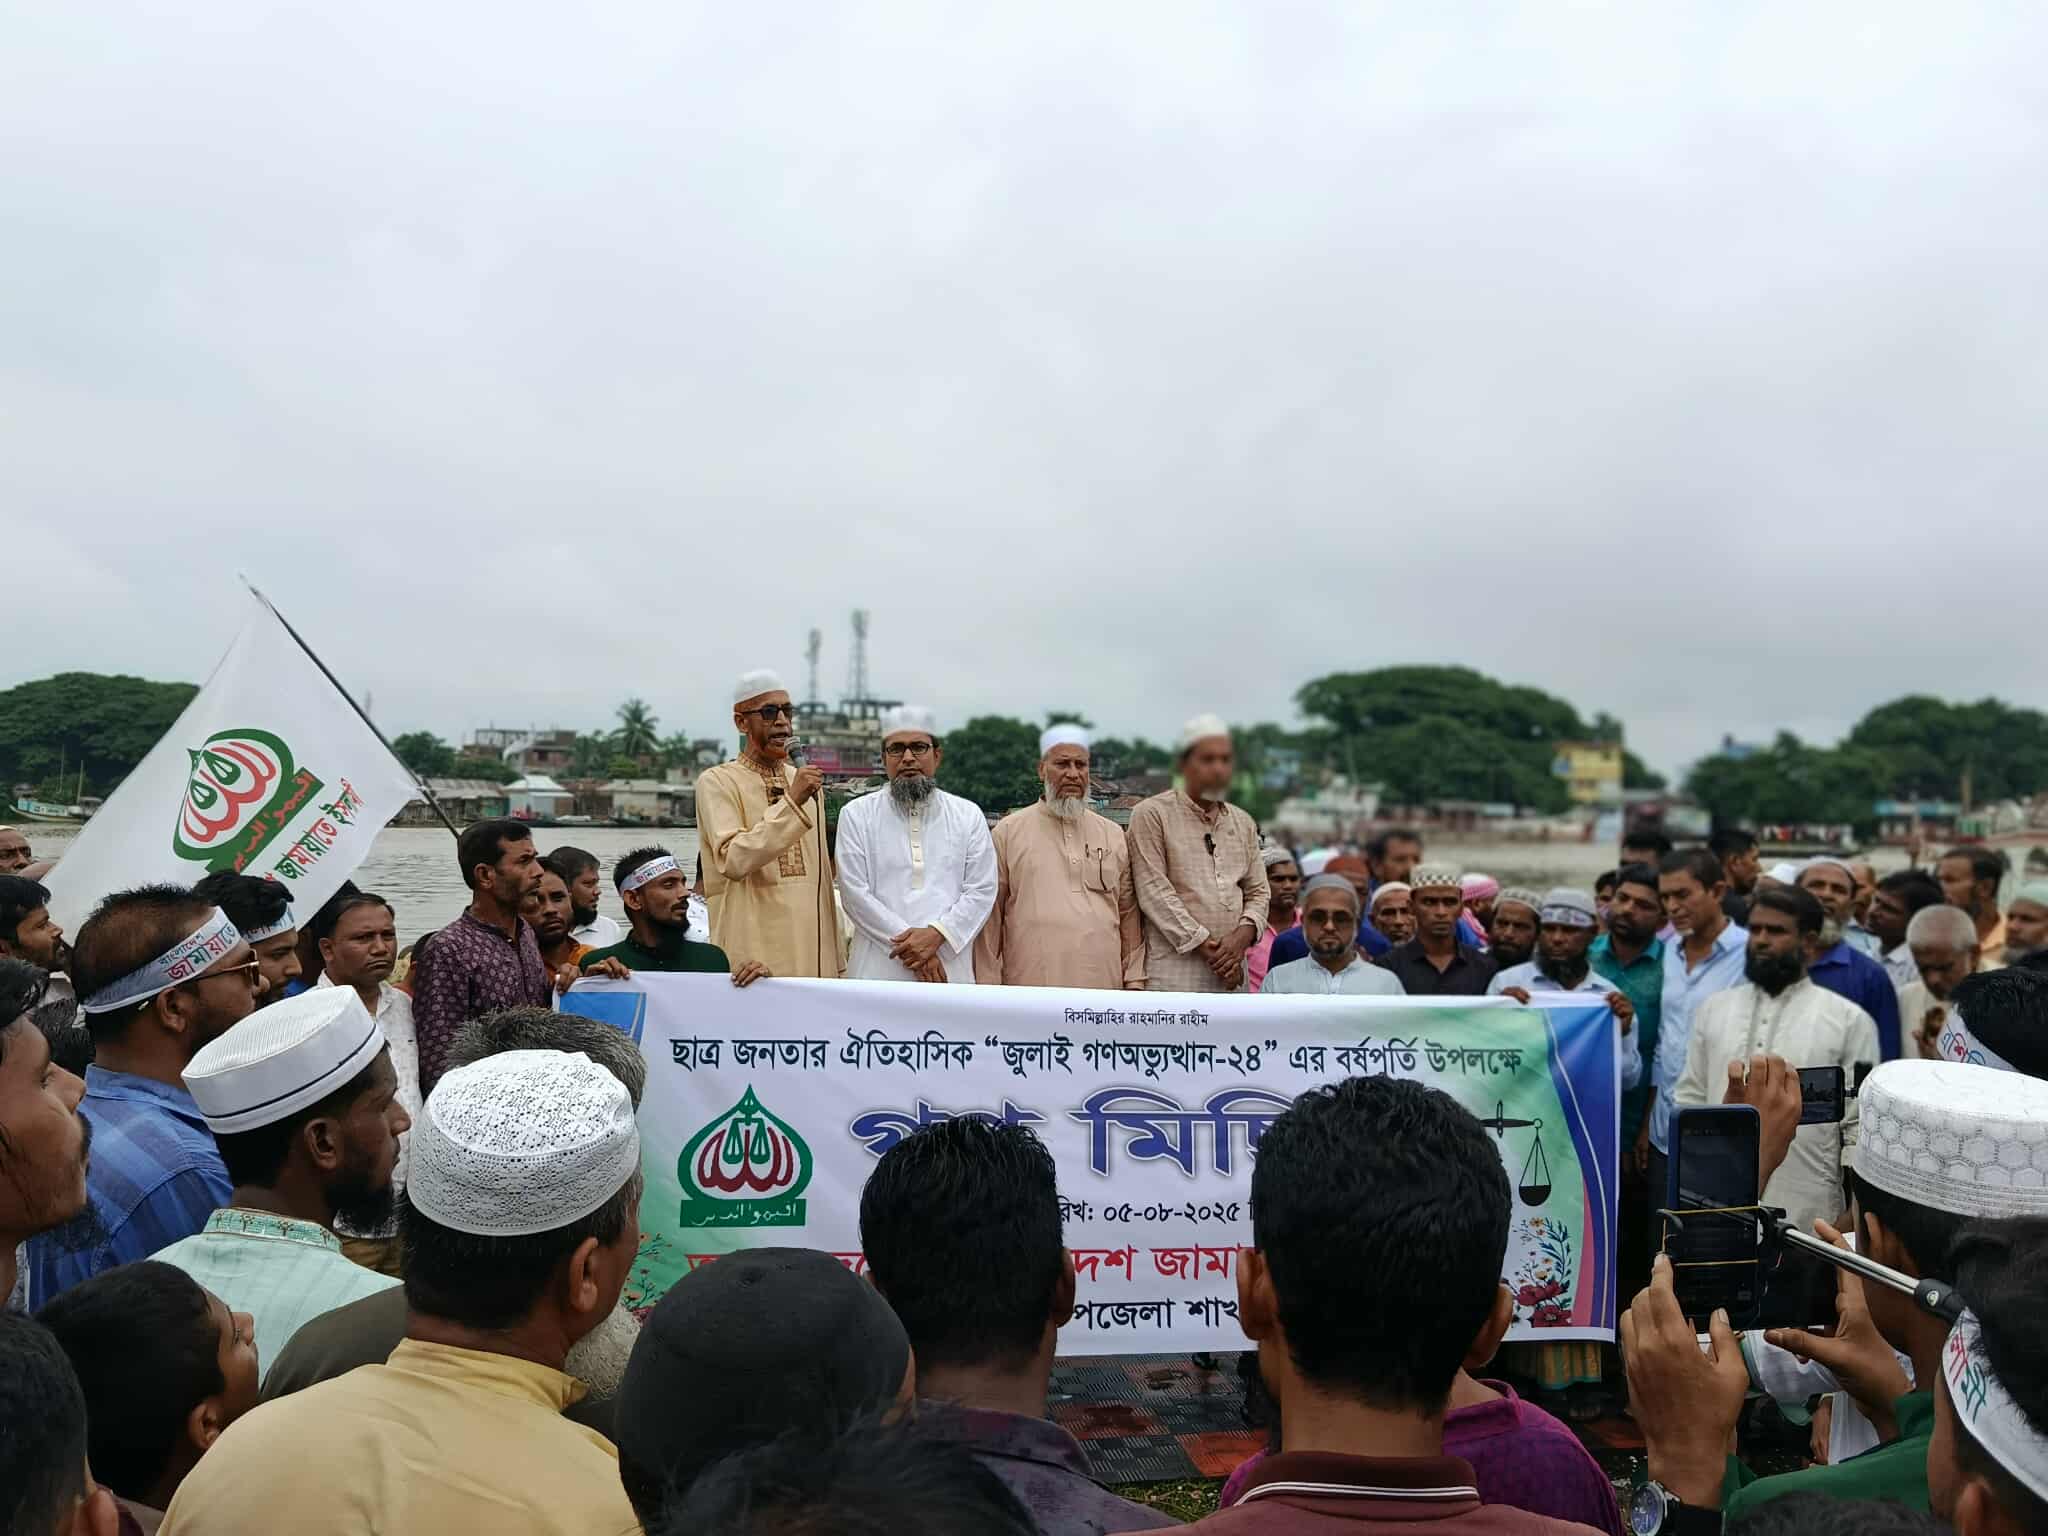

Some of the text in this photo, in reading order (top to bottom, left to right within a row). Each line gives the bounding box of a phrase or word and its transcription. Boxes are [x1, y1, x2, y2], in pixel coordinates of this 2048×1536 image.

[164, 922, 237, 979] জামায়াতে
[1064, 1007, 1209, 1027] বিসমিল্লাহির রাহমানির রাহীম
[669, 1035, 723, 1072] ছাত্র
[731, 1035, 831, 1070] জনতার
[840, 1027, 975, 1074] ঐতিহাসিক
[1289, 1046, 1328, 1074] এর
[1333, 1036, 1419, 1075] বর্ষপর্তি
[1424, 1039, 1523, 1075] উপলক্ষে
[1103, 1201, 1241, 1224] ০৫-০৮-২০২৫
[1074, 1298, 1176, 1330] পজেলা
